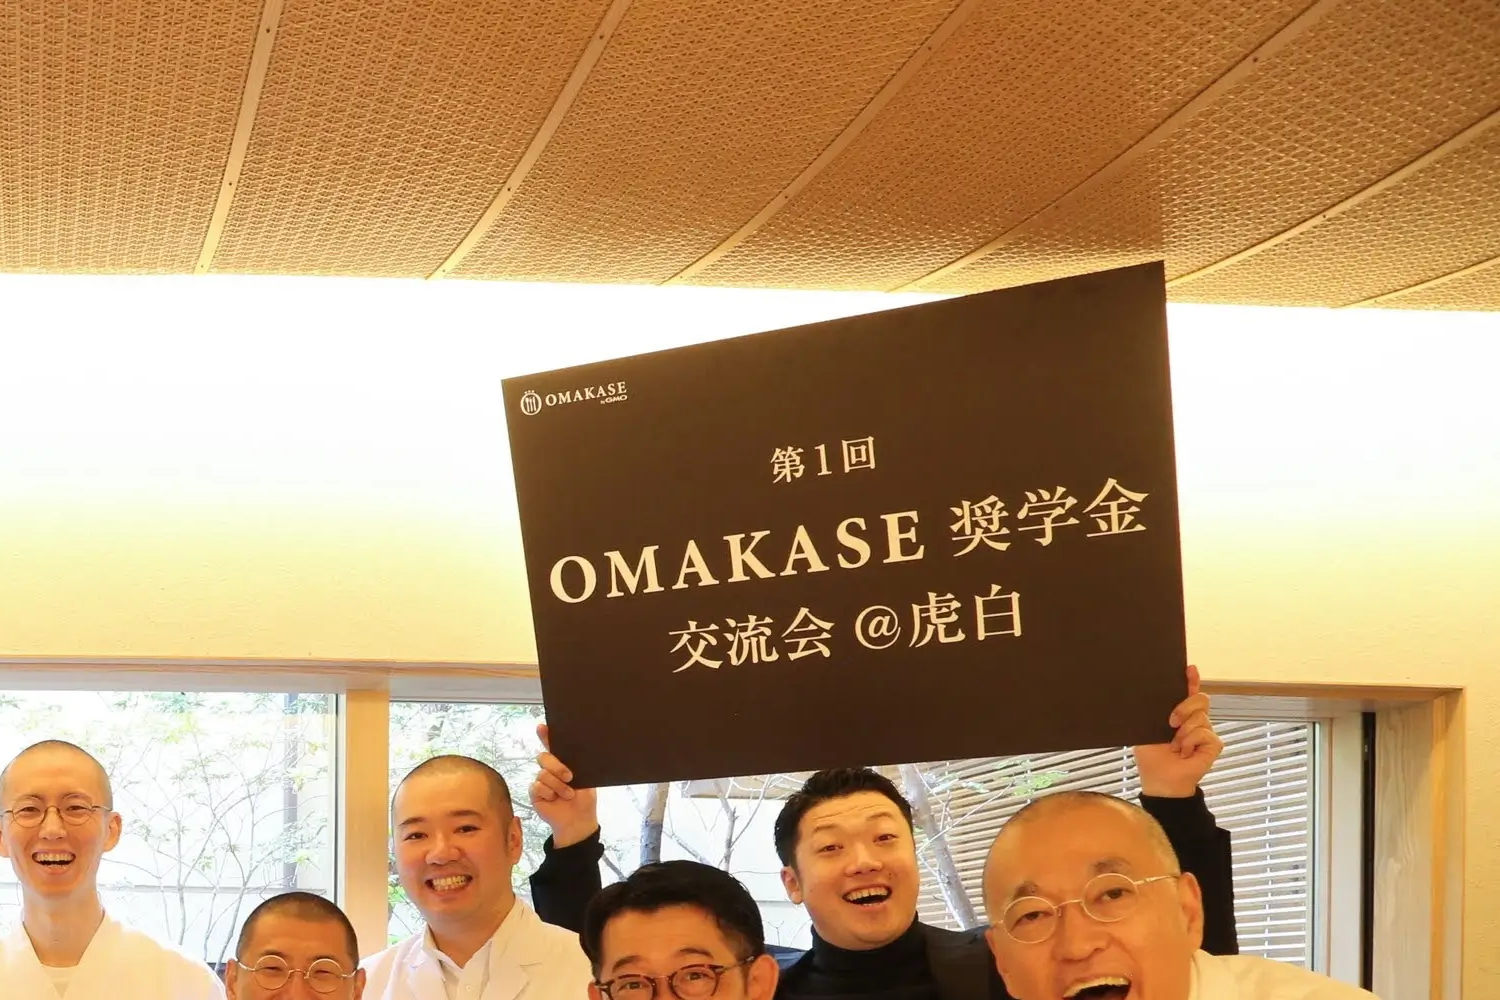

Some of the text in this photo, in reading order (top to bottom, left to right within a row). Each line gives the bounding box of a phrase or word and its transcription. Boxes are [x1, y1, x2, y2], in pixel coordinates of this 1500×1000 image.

[545, 381, 627, 407] OMAKASE
[605, 394, 628, 404] GMO
[770, 435, 876, 484] 第1回
[549, 477, 1150, 604] OMAKASE 奨学金
[668, 583, 1023, 673] 交流会 @虎白
